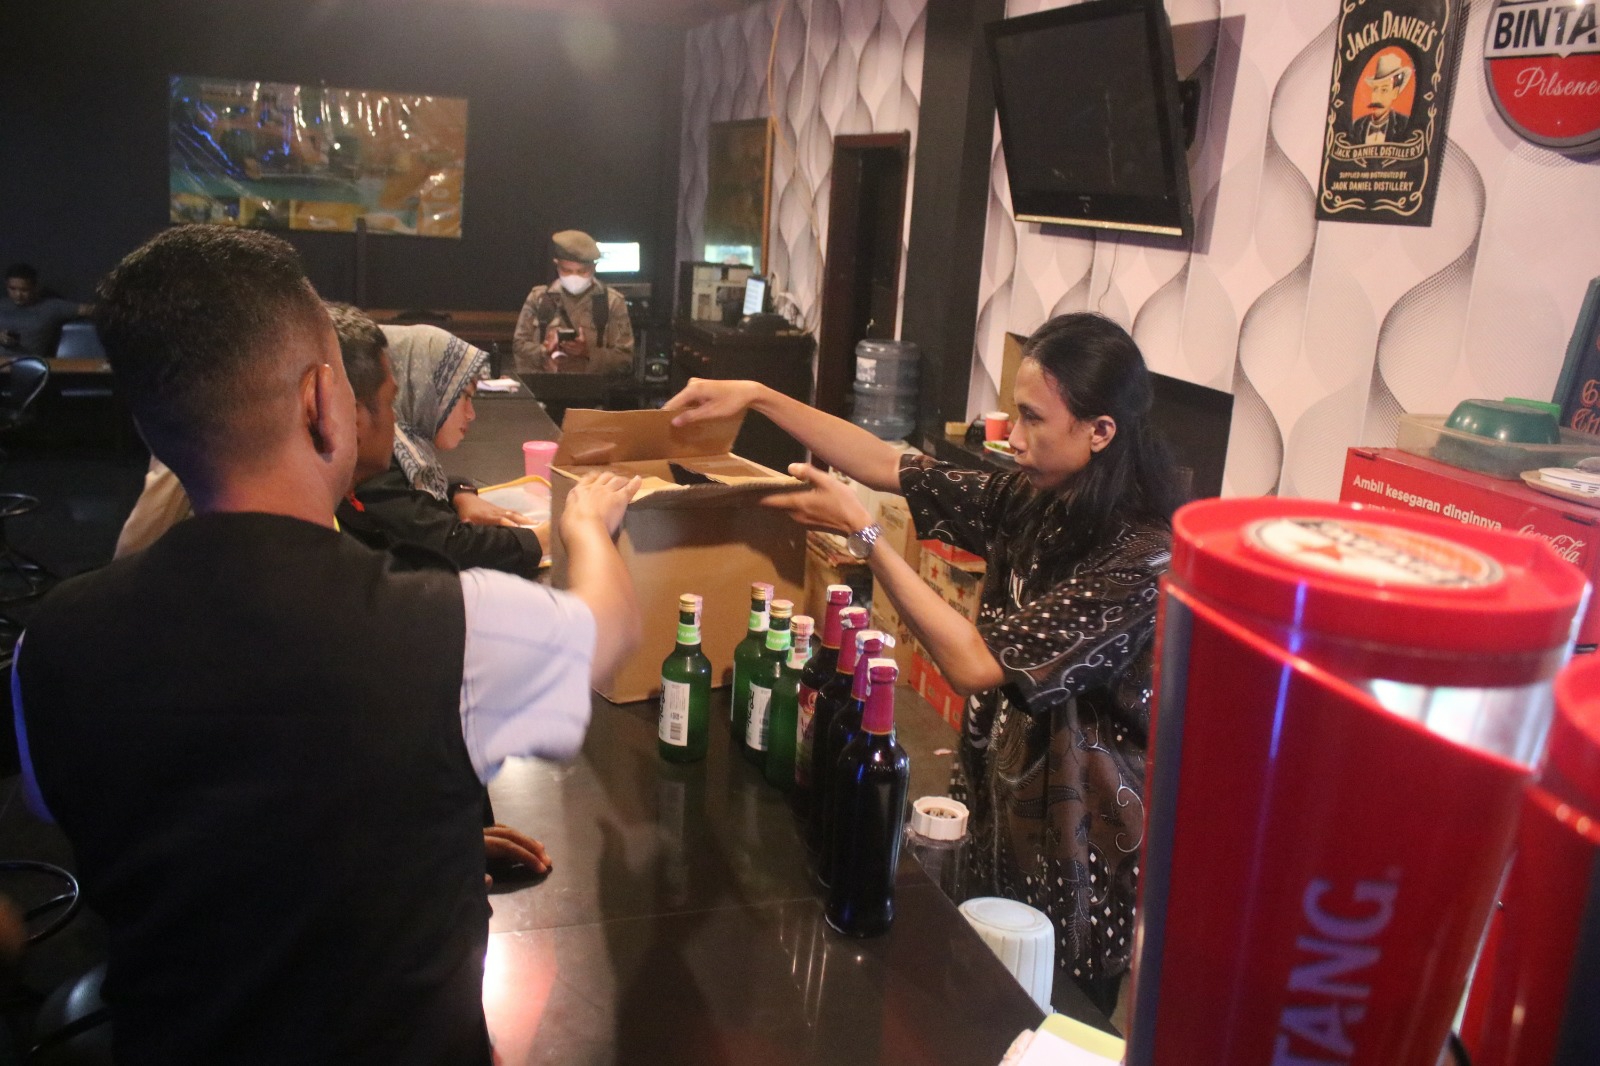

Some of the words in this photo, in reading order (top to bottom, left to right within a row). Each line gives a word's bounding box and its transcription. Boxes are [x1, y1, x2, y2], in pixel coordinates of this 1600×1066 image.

[1346, 20, 1380, 61] JACK
[1381, 10, 1438, 52] DANIEL'S
[1334, 148, 1351, 158] JACK
[1353, 147, 1378, 158] DANIEL
[1380, 145, 1421, 157] DISTILLERY
[1331, 181, 1348, 191] JACK
[1349, 181, 1372, 191] DANIEL
[1373, 182, 1413, 192] DISTILLERY
[1353, 474, 1384, 495] Ambil
[1385, 484, 1441, 513] kesegaran
[1443, 503, 1502, 531] dinginnya
